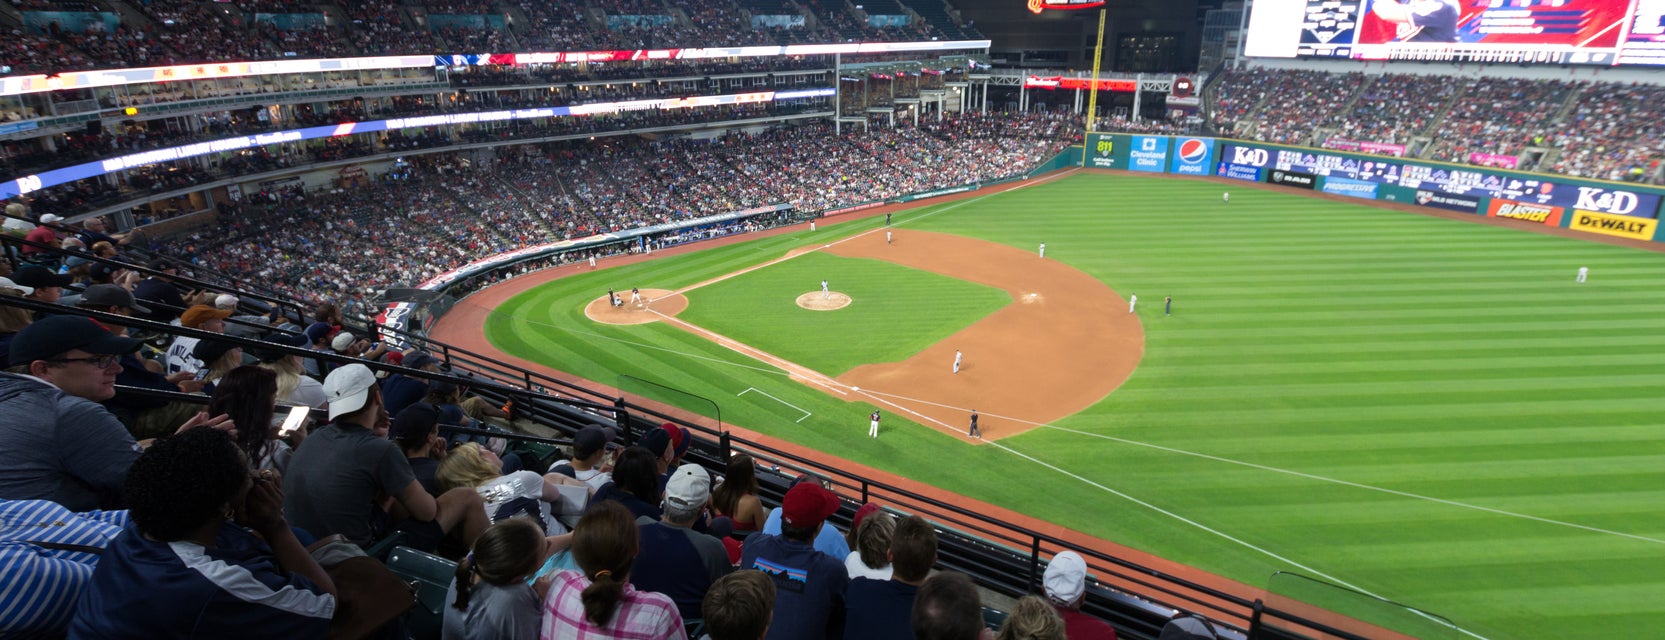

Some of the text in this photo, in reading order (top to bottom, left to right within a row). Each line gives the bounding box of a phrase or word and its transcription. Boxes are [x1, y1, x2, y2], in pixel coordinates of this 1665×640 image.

[1097, 140, 1113, 152] 811
[1130, 150, 1166, 159] Cleveland
[1233, 146, 1268, 167] K&D
[1136, 158, 1158, 166] Clinic
[1179, 164, 1202, 173] pepsi
[1284, 175, 1311, 184] RAM
[1323, 182, 1376, 193] PROGRESSIVE
[1446, 198, 1477, 208] NETWORK
[1573, 186, 1638, 214] K&D
[1496, 203, 1551, 222] BLASTER
[169, 344, 193, 363] ANTLE
